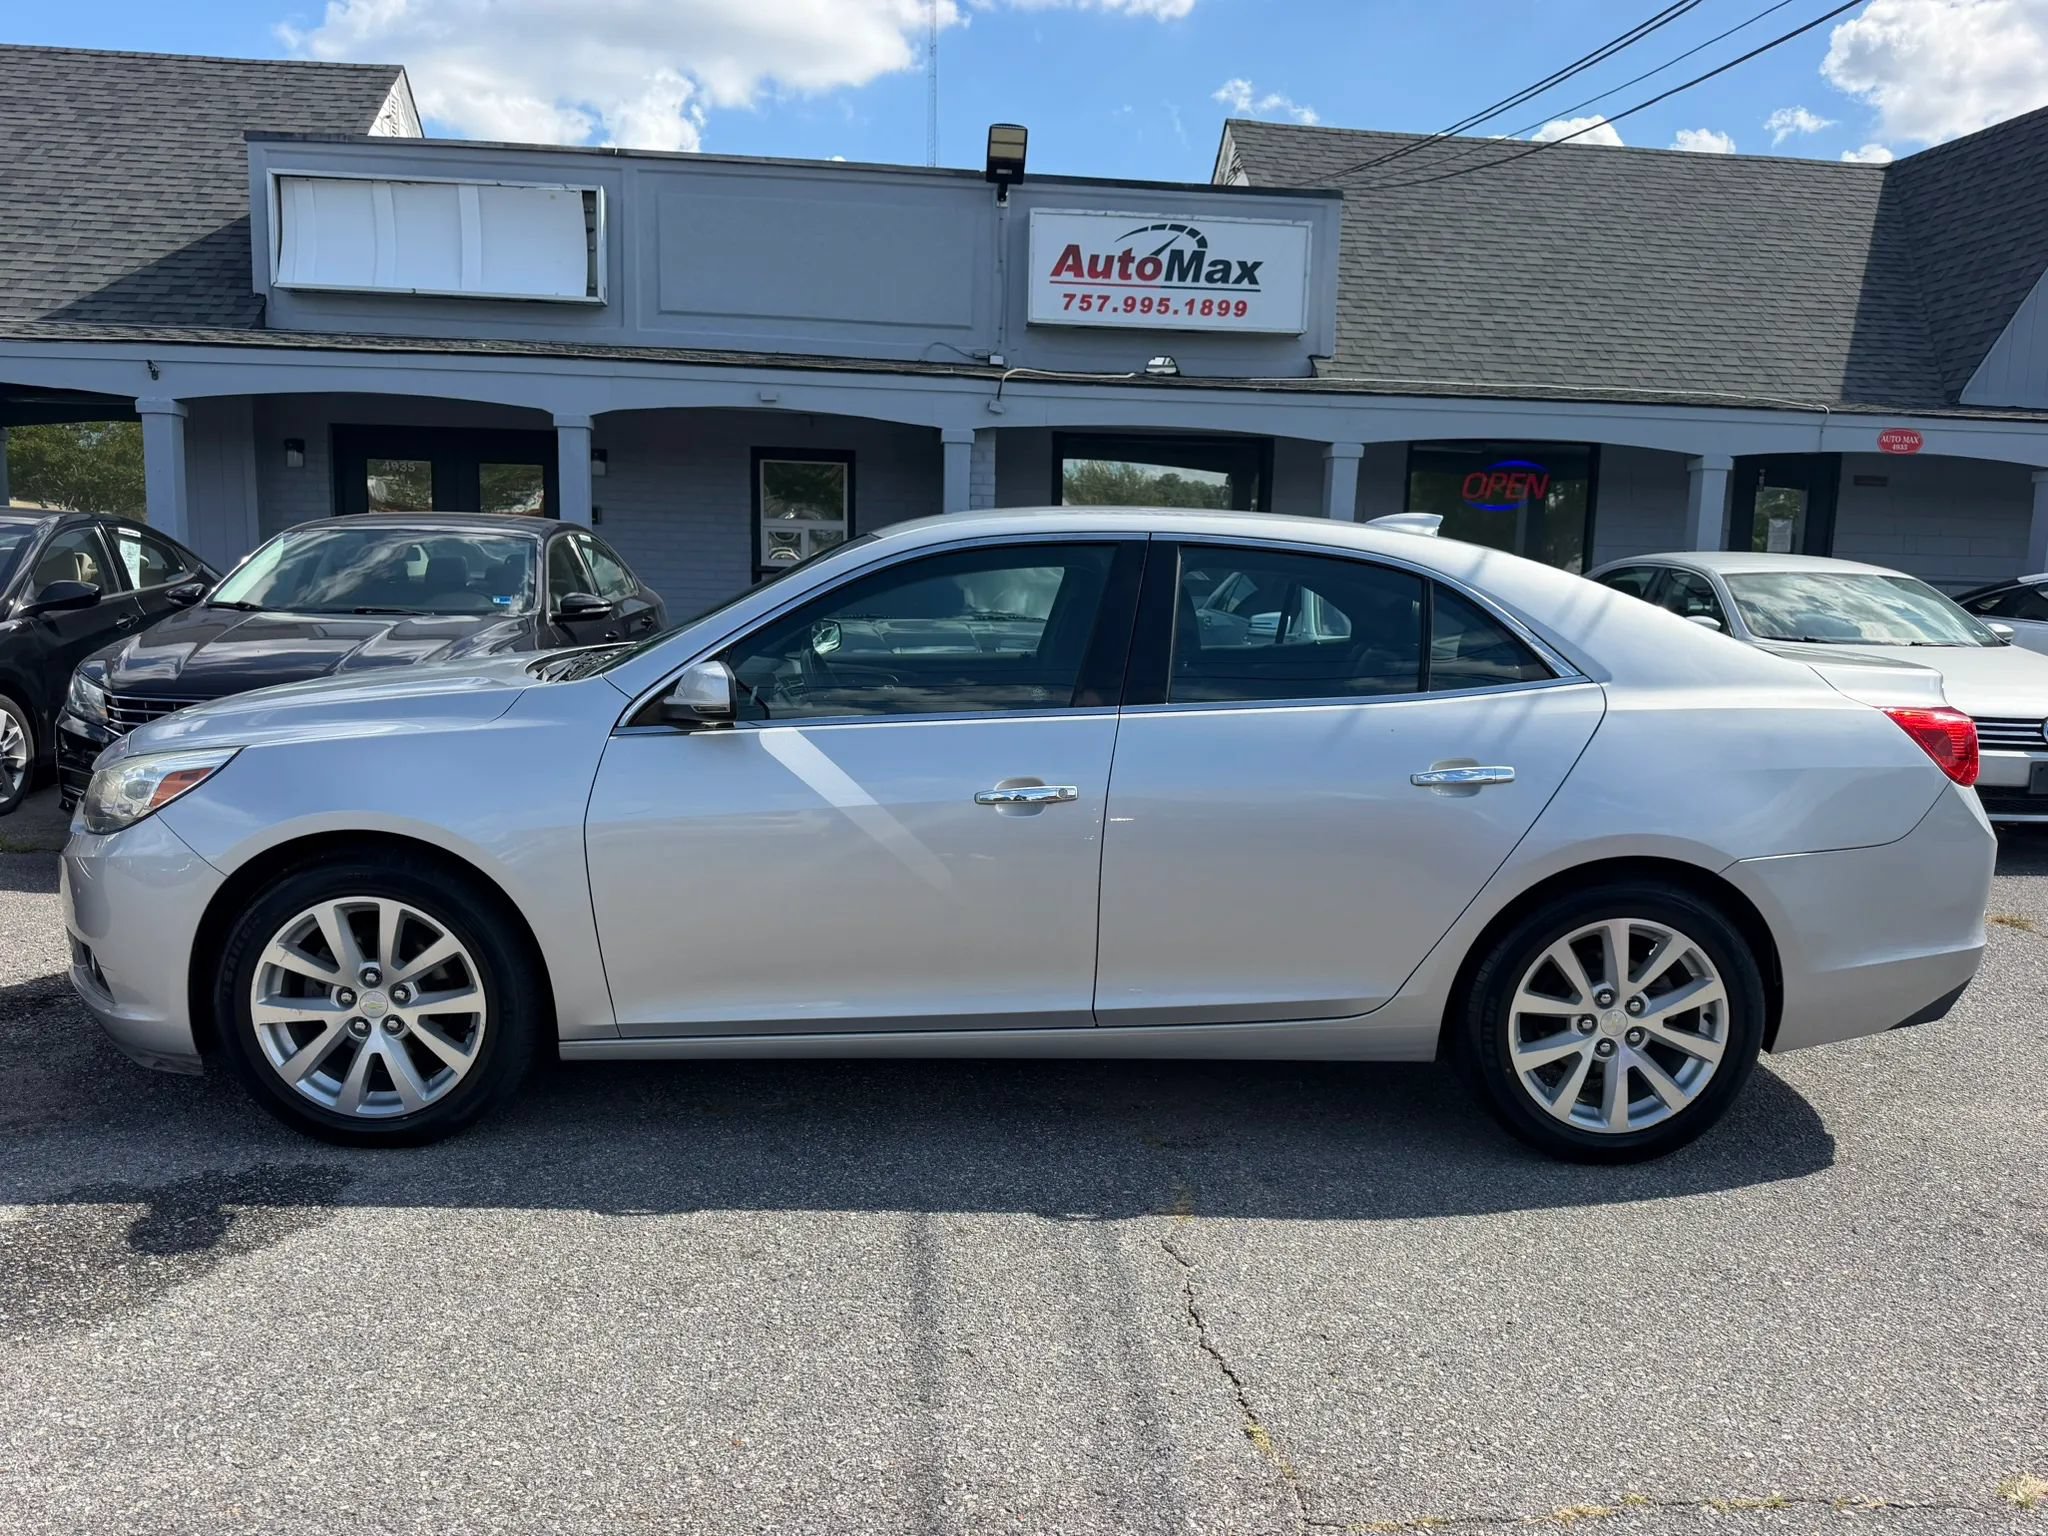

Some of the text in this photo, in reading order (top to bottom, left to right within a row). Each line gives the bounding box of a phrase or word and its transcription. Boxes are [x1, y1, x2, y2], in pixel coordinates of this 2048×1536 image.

[1050, 244, 1264, 285] AutoMax
[1062, 292, 1249, 318] 757.995.1899
[1881, 435, 1919, 444] AUTO MAX
[383, 461, 416, 472] 4935
[1461, 472, 1551, 499] OPEN
